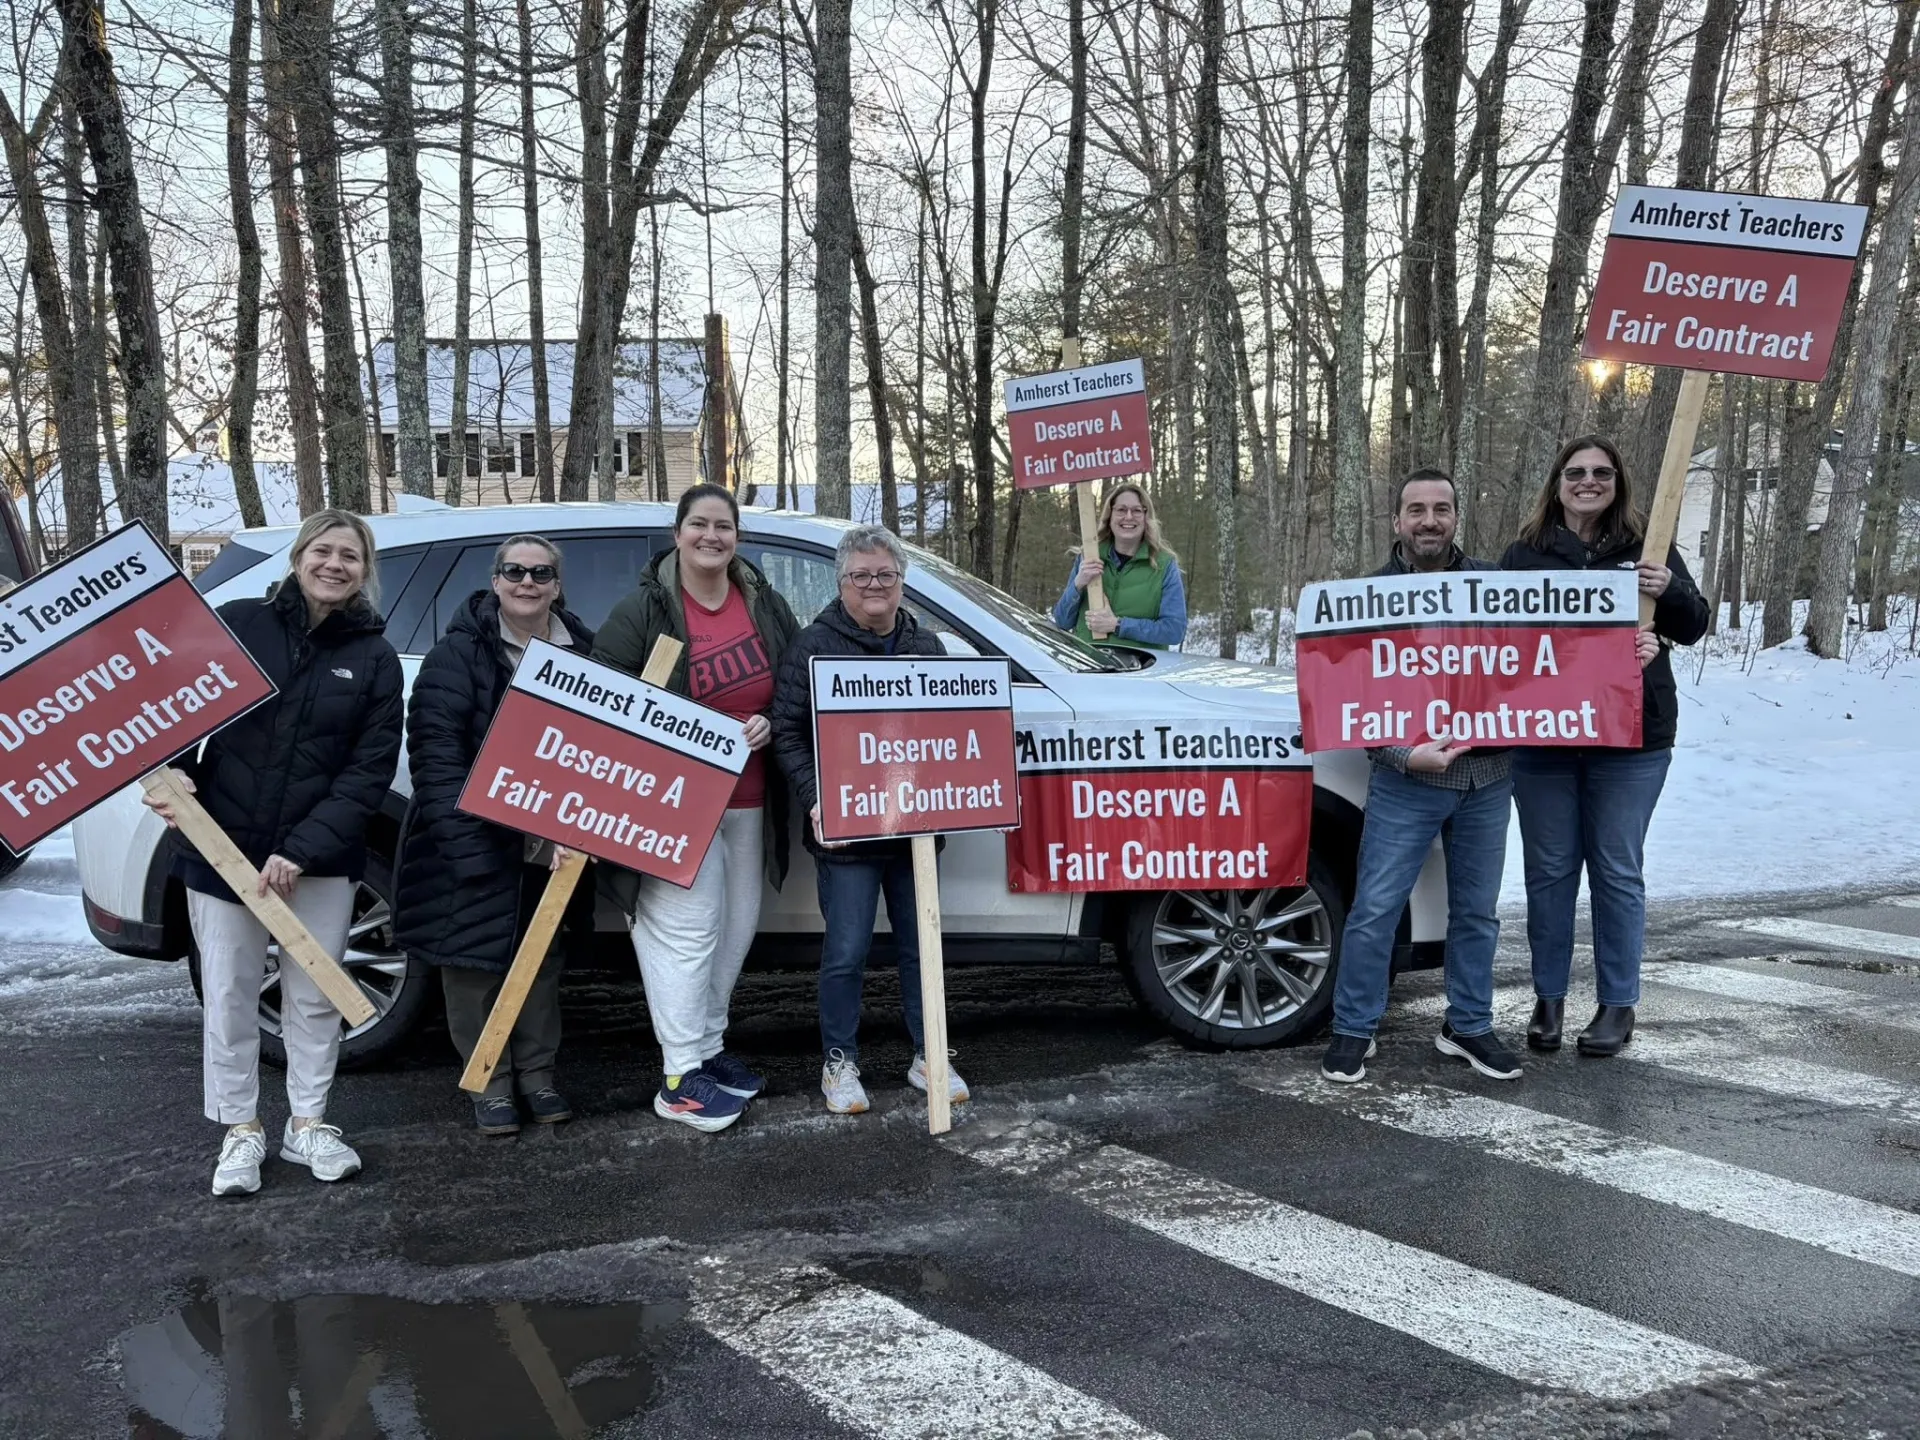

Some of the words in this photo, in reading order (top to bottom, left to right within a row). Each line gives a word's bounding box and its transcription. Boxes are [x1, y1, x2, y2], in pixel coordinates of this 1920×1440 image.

[1630, 200, 1730, 232] Amherst
[1738, 208, 1844, 242] Teachers
[1643, 261, 1767, 304] Deserve
[1776, 275, 1797, 307] A
[1606, 309, 1667, 345] Fair
[1675, 316, 1814, 361] Contract
[1015, 380, 1070, 402] Amherst
[1073, 372, 1133, 392] Teachers
[1034, 418, 1104, 442] Deserve
[1110, 410, 1122, 431] A
[1024, 454, 1057, 476] Fair
[1063, 442, 1140, 471] Contract
[18, 555, 147, 634] Teachers
[1314, 582, 1453, 624] Amherst
[1463, 578, 1615, 614] Teachers
[1372, 638, 1518, 678] Deserve
[1533, 634, 1558, 676] A
[0, 654, 136, 752] Deserve
[134, 627, 172, 666] A
[832, 673, 912, 698] Amherst
[917, 672, 998, 697] Teachers
[534, 659, 635, 716] Amherst
[640, 699, 736, 756] Teachers
[1341, 701, 1412, 741] Fair
[1426, 700, 1598, 741] Contract
[0, 760, 79, 818] Fair
[77, 660, 238, 768] Contract
[859, 733, 957, 765] Deserve
[966, 729, 981, 760] A
[1021, 728, 1144, 763] Amherst
[1154, 726, 1290, 759] Teachers
[535, 726, 656, 797] Deserve
[661, 776, 685, 808] A
[487, 766, 552, 814] Fair
[557, 791, 689, 864] Contract
[840, 784, 888, 818] Fair
[898, 779, 1002, 814] Contract
[1072, 780, 1206, 819] Deserve
[1218, 778, 1240, 816] A
[1048, 842, 1109, 882] Fair
[1121, 840, 1268, 880] Contract
